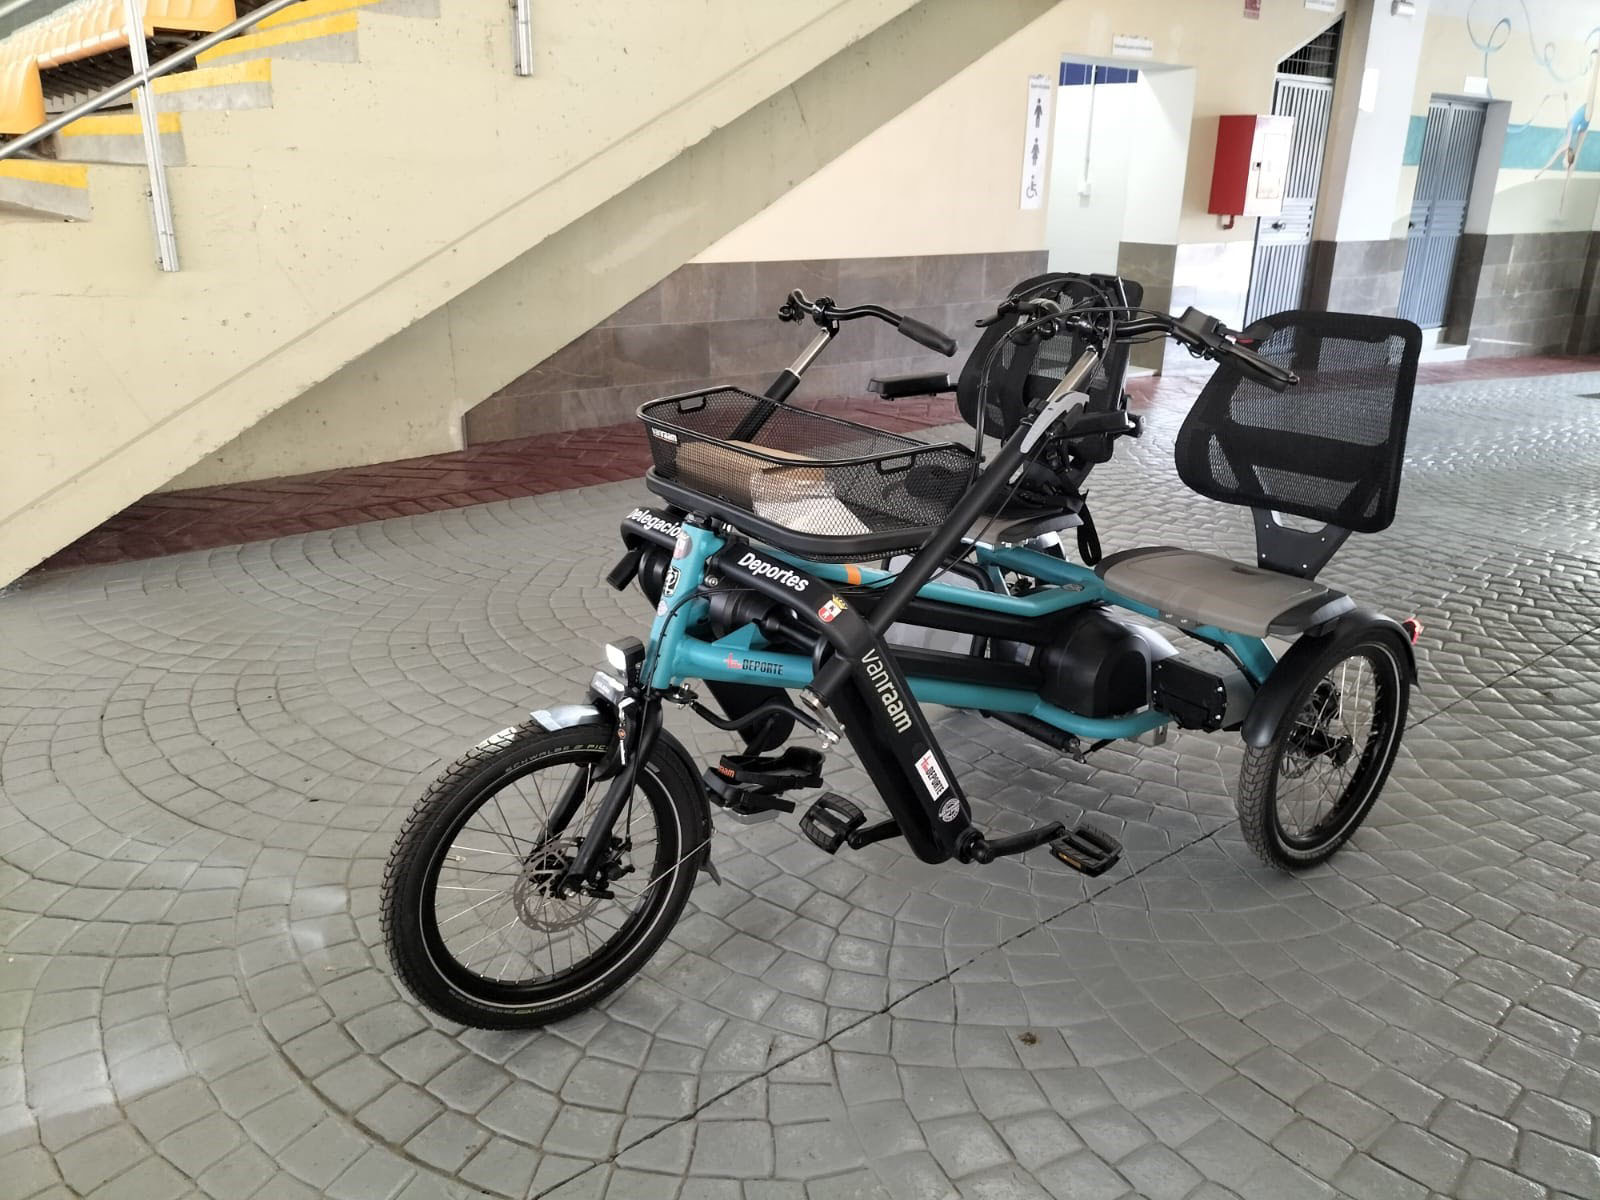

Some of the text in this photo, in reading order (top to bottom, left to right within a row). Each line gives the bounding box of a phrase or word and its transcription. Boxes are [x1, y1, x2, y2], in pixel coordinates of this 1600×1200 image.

[625, 507, 683, 538] elegacio
[737, 552, 809, 592] Deportes
[742, 658, 785, 675] DEPORTE
[861, 648, 913, 734] vanraam
[925, 766, 945, 796] DEPORTE
